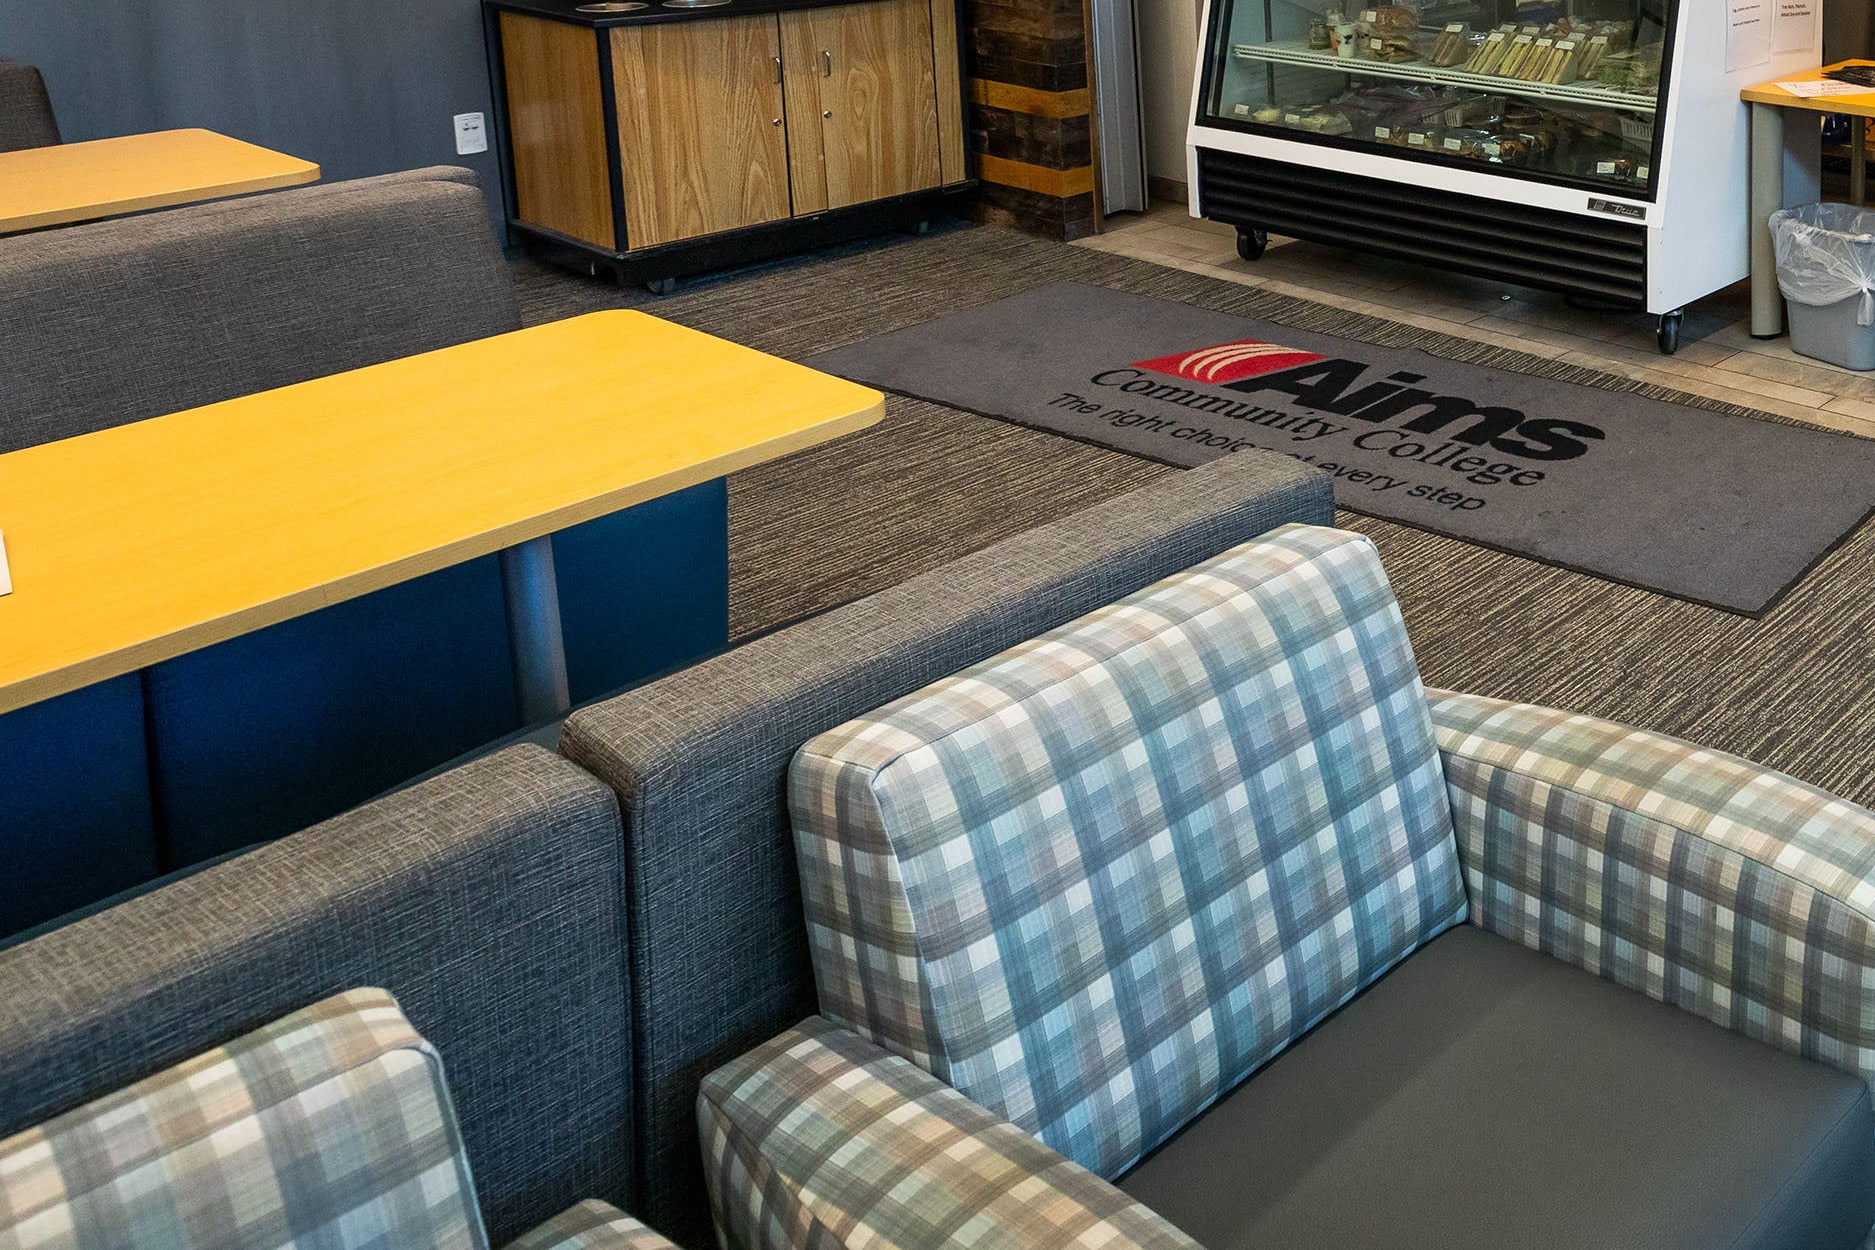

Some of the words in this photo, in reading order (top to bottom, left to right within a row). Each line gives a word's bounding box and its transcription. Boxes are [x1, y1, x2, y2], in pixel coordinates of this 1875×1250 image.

[1048, 393, 1104, 415] The
[1099, 409, 1178, 433] right
[1317, 460, 1408, 492] every
[1407, 484, 1486, 511] step
[1090, 368, 1349, 441] Community
[1353, 430, 1546, 487] College
[1218, 358, 1606, 461] Aims
